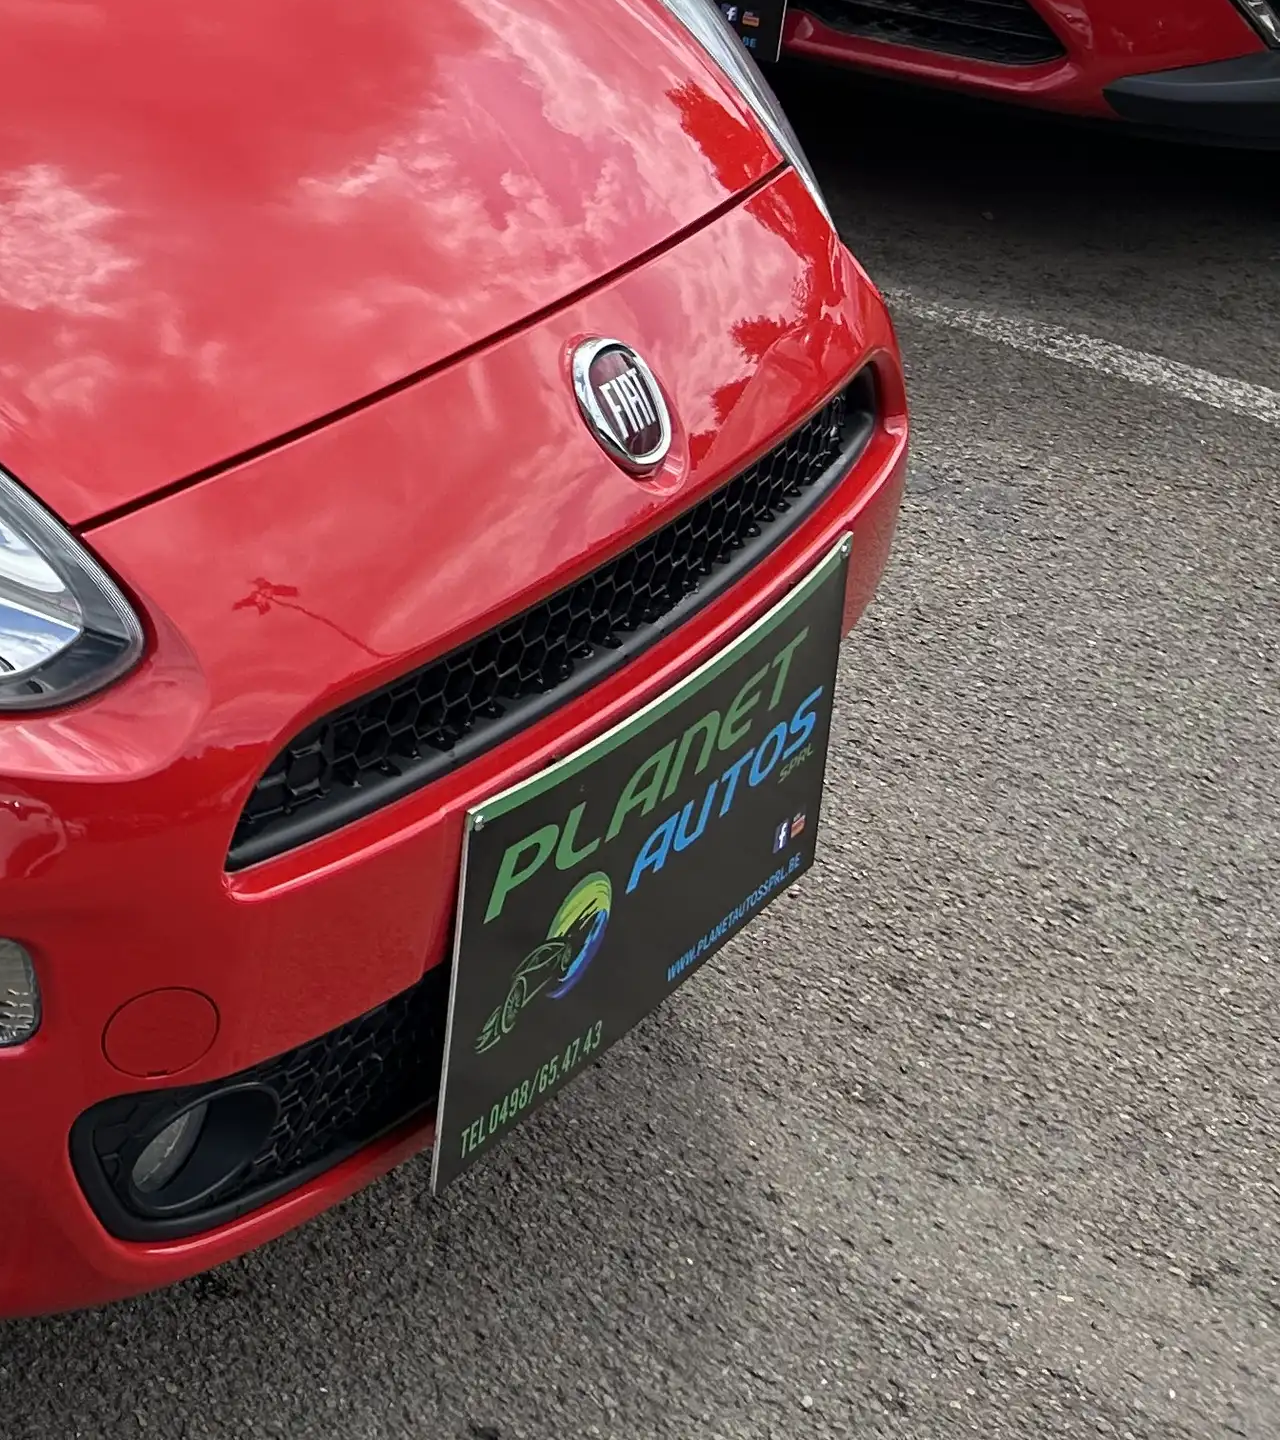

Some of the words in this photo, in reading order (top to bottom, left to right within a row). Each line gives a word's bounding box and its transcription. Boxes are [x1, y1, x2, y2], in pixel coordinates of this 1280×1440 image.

[598, 367, 657, 441] FIAT
[484, 625, 809, 924] PLANET
[625, 685, 825, 895] AUTOS
[778, 742, 814, 784] SPRL
[666, 851, 802, 982] WWW.PLANETAUTOSSPRL.BE
[460, 1115, 487, 1160] TEL
[488, 1019, 603, 1135] 0498/65.47.43
